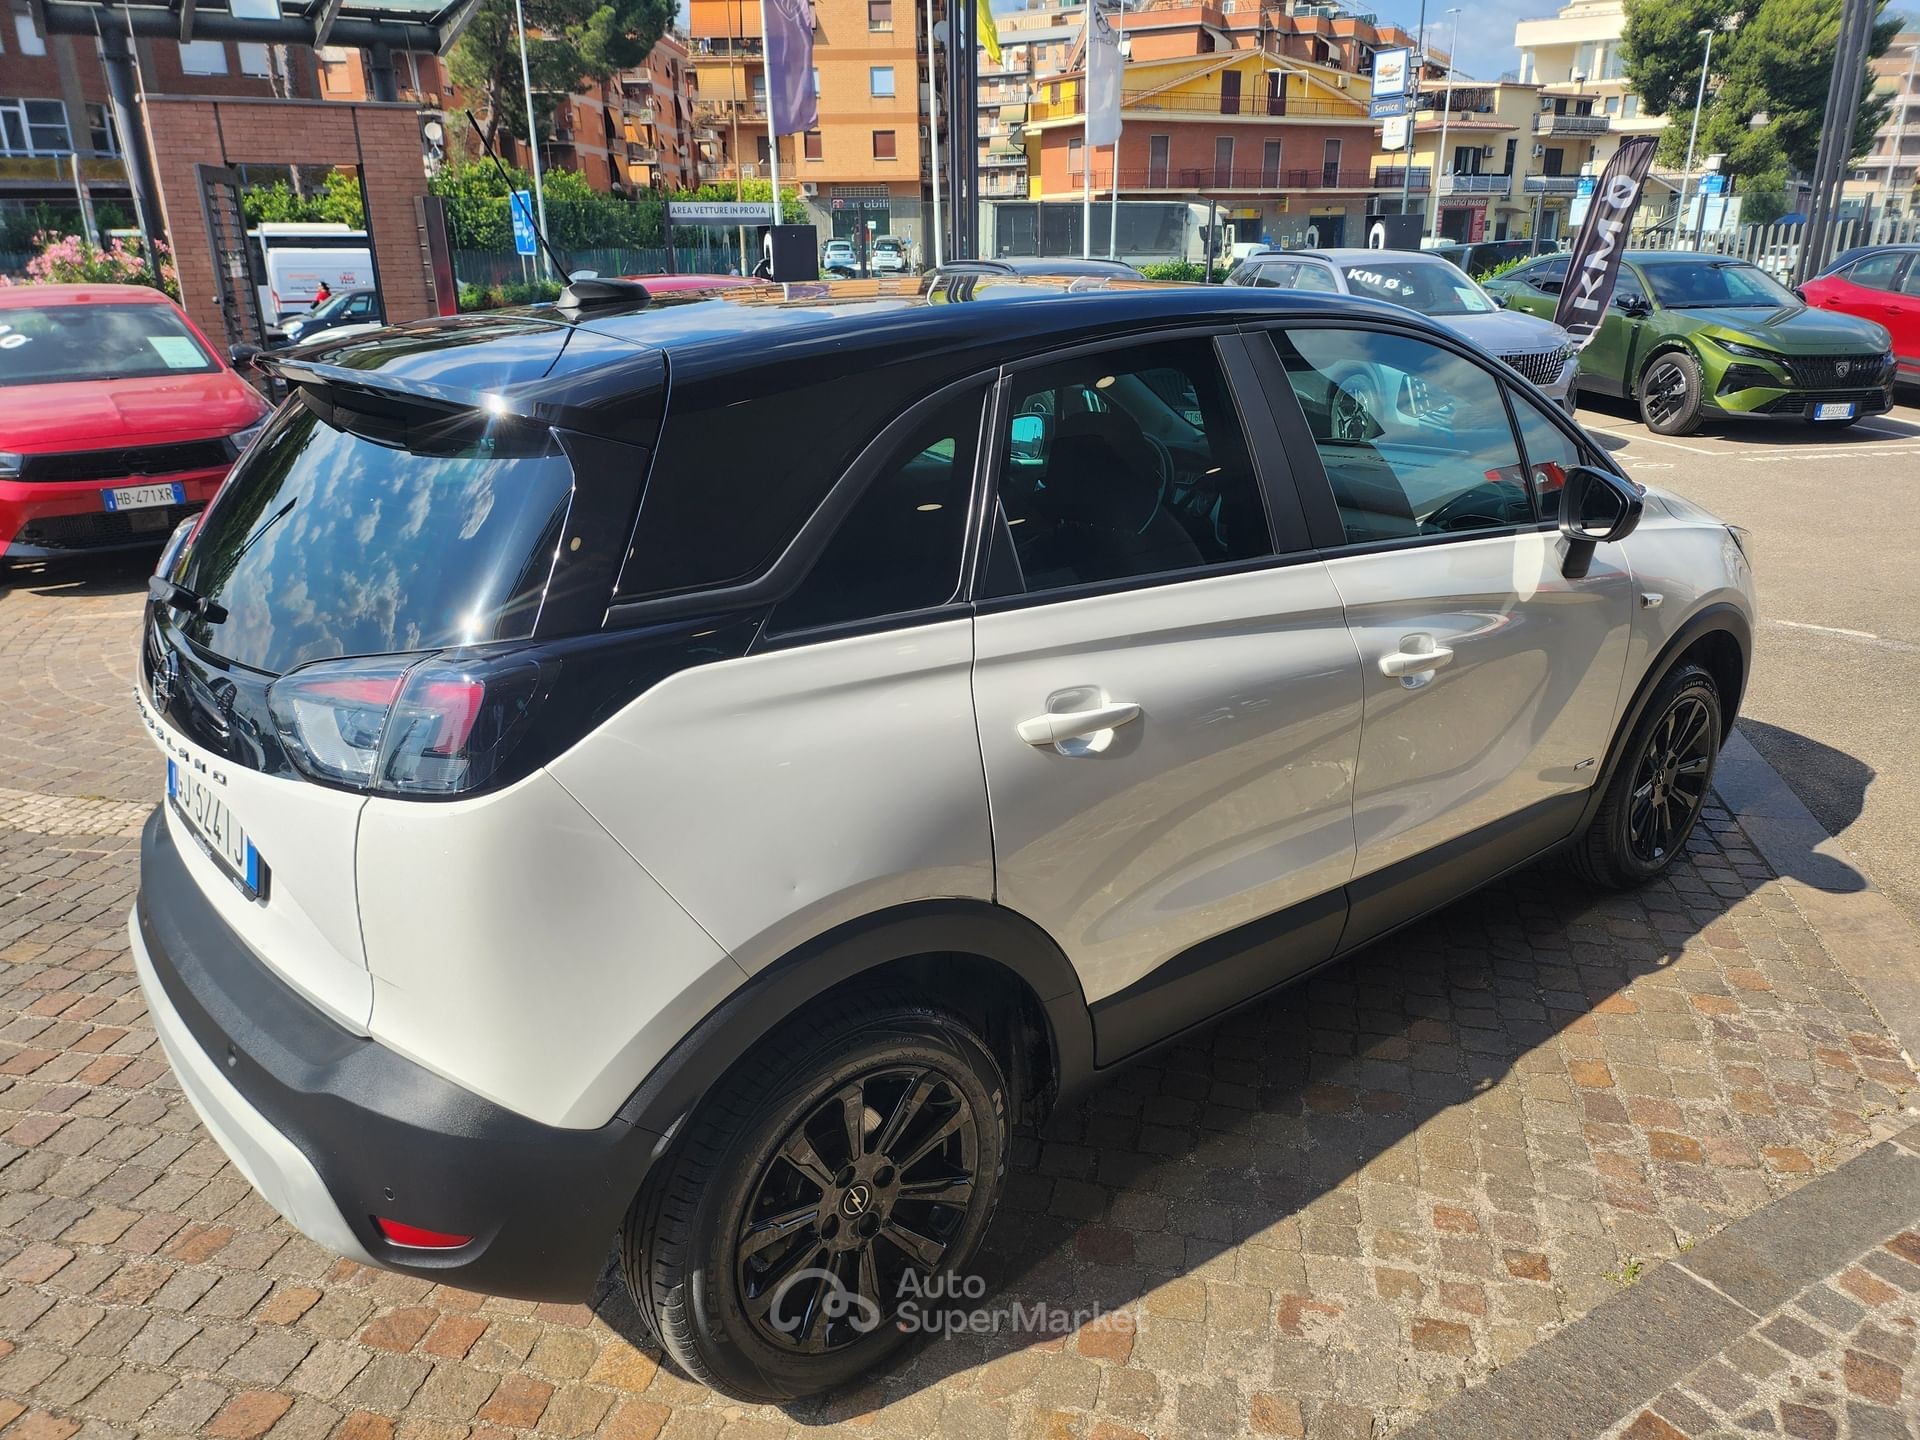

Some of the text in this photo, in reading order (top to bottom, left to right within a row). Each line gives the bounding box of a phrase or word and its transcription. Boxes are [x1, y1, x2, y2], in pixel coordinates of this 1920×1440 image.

[1374, 103, 1399, 114] Service
[671, 206, 766, 214] AREA VETTURE IN PROVA
[1573, 218, 1625, 312] KM
[1347, 268, 1383, 285] KM
